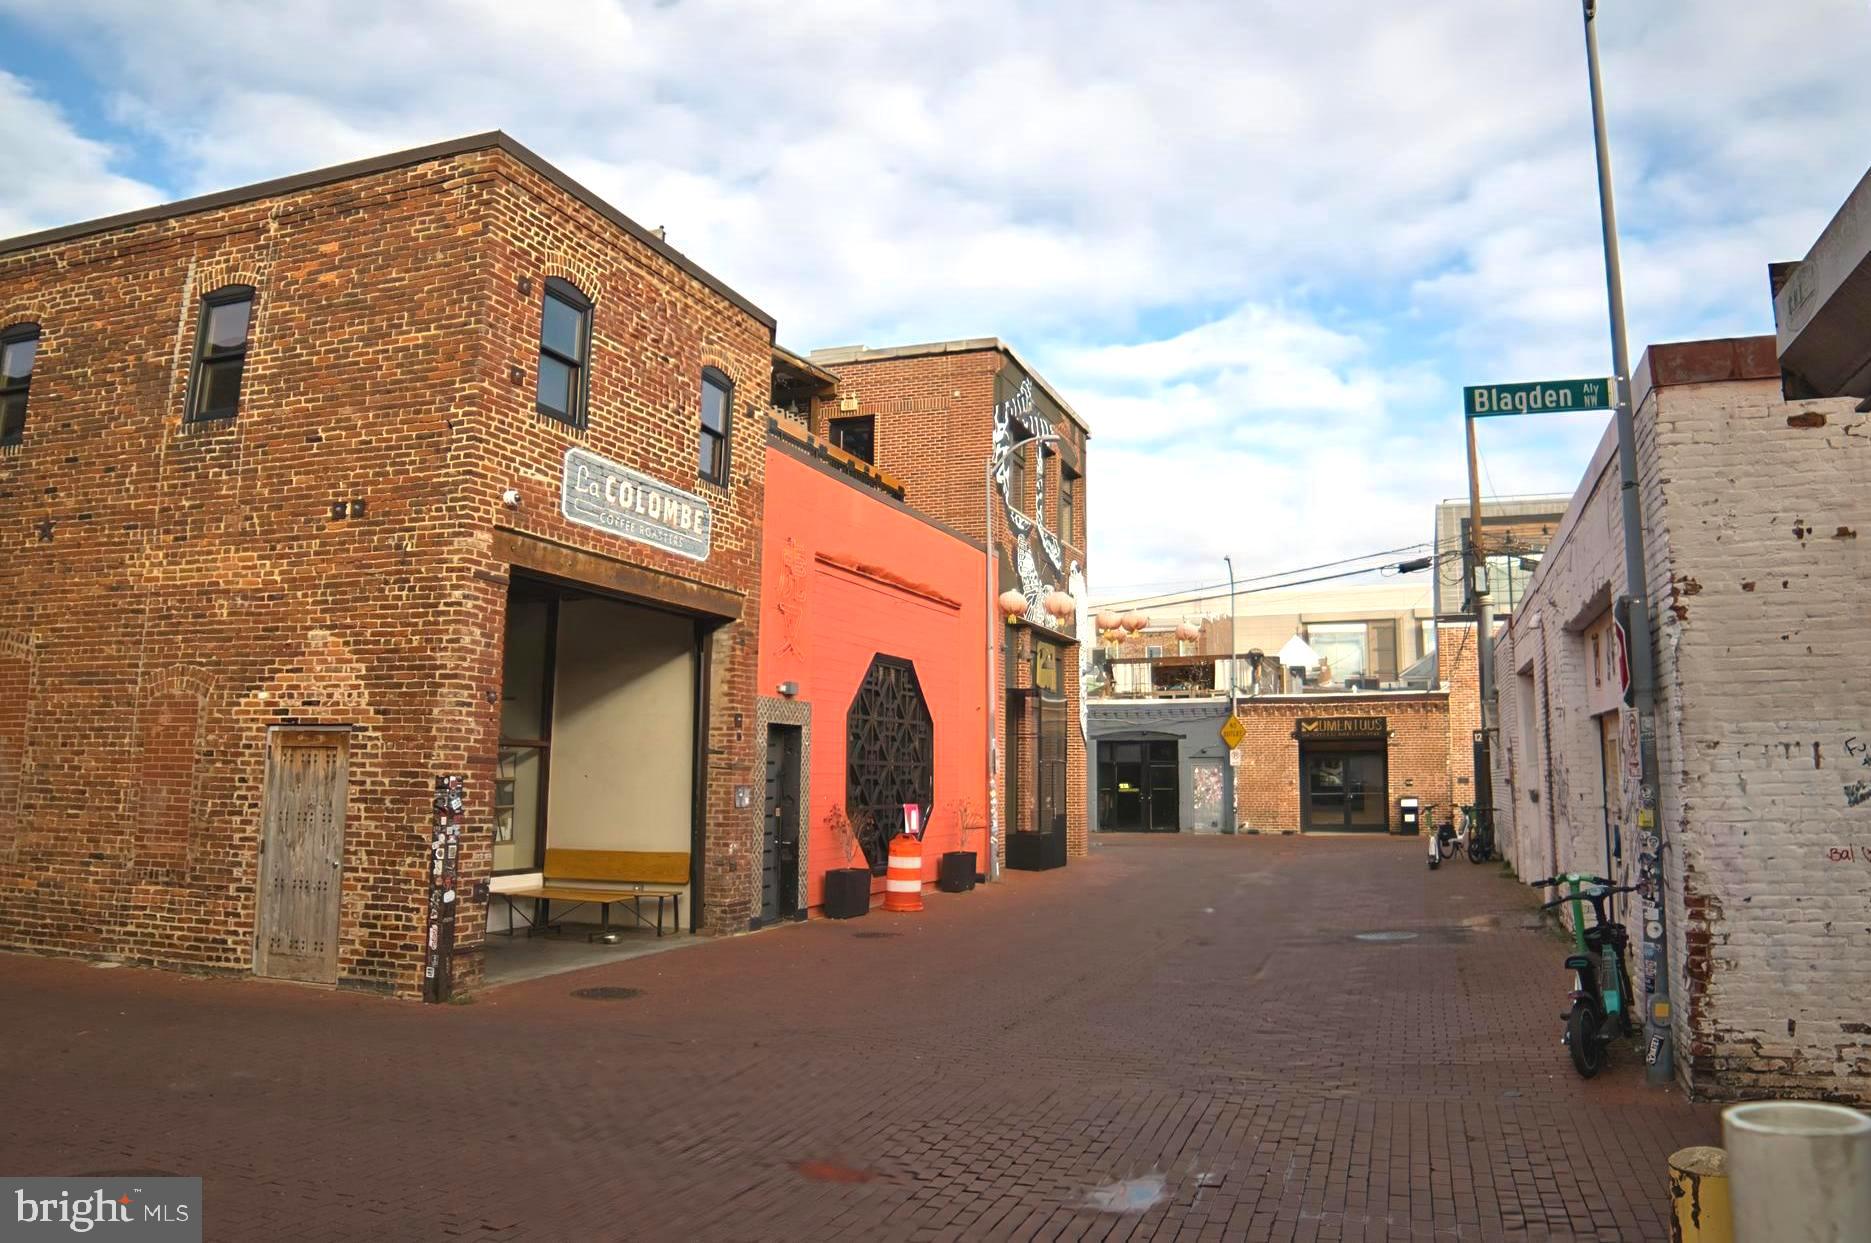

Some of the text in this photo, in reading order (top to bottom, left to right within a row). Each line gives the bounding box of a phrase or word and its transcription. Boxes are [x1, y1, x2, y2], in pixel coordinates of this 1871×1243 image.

[1474, 383, 1599, 414] Blagden Aly
[1584, 394, 1598, 408] NW
[575, 465, 705, 535] La COLOMBE
[599, 512, 684, 548] COFFEE ROASTERS
